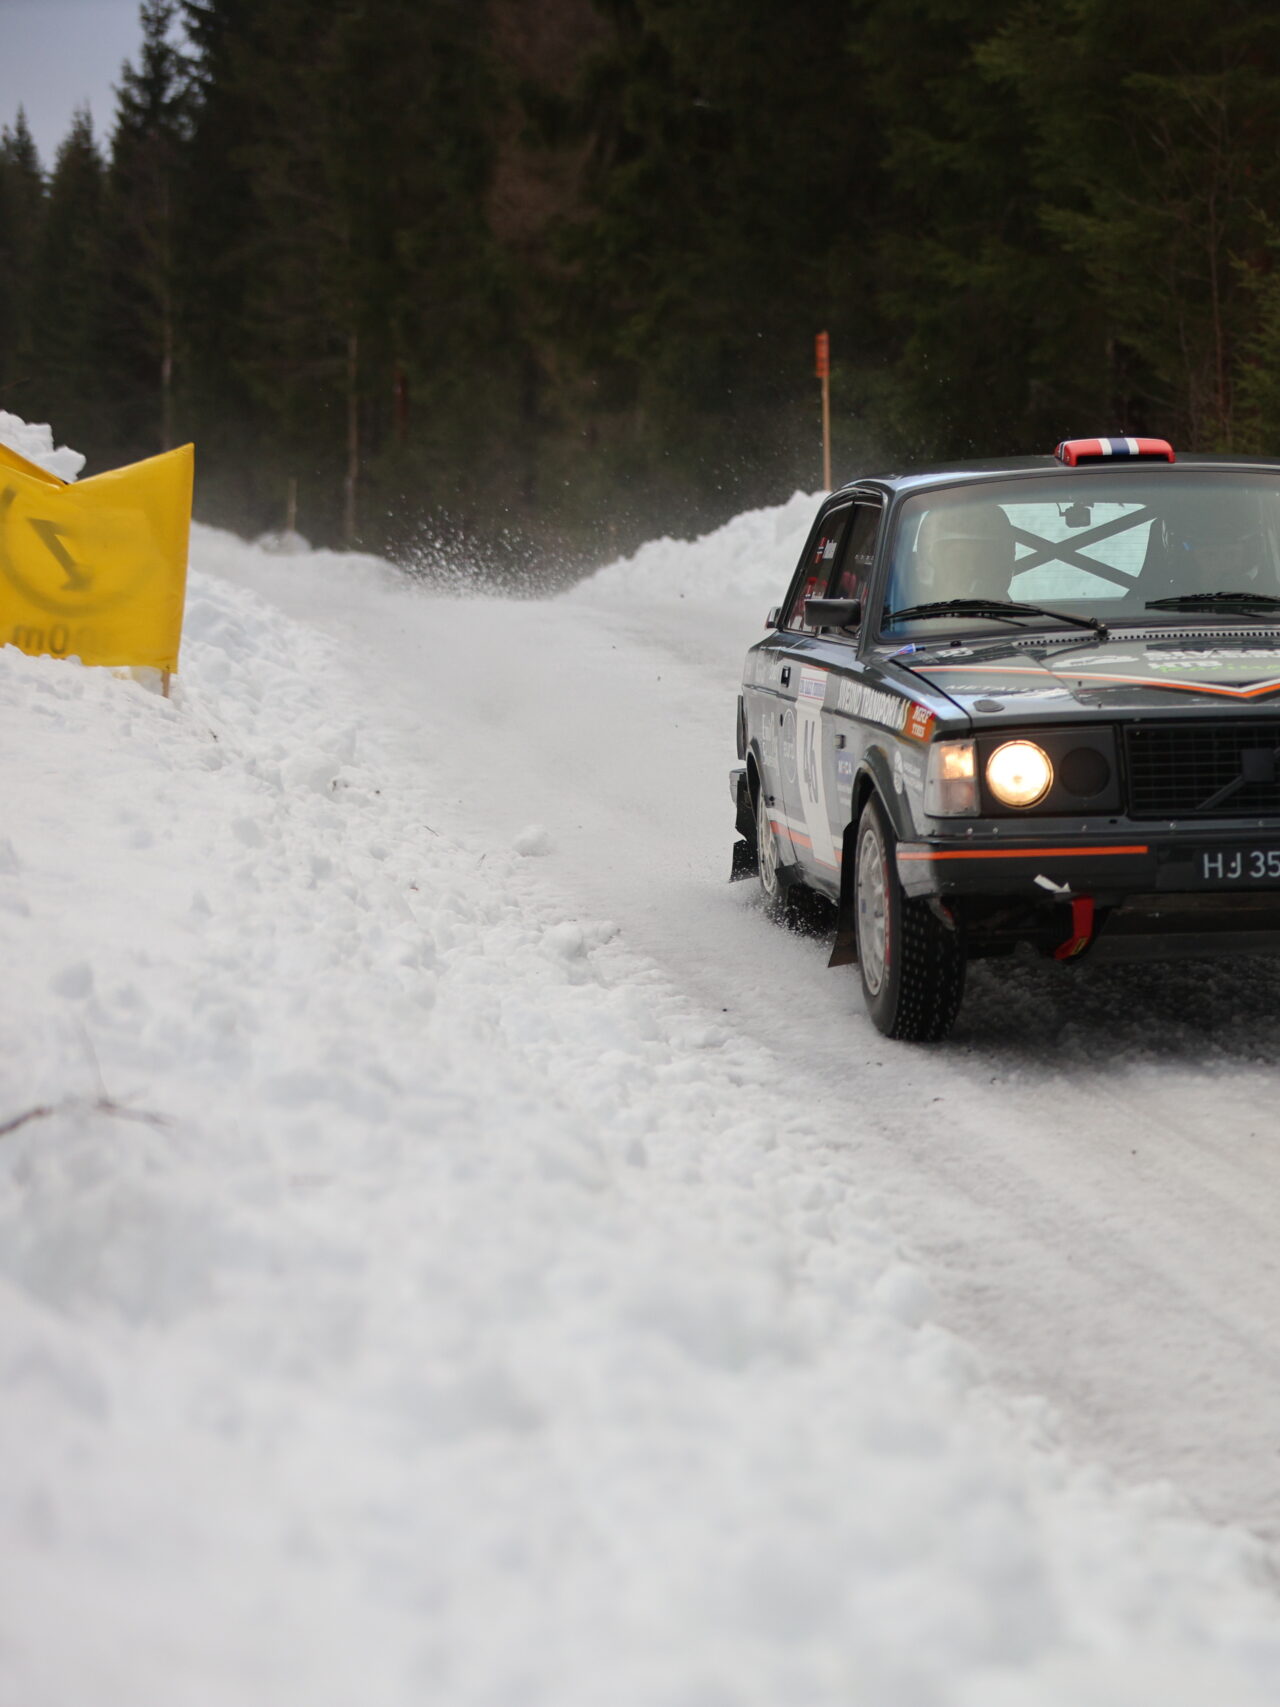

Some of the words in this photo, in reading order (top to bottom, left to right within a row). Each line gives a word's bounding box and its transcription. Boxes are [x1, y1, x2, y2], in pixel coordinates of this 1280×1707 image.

[896, 698, 912, 731] AS
[912, 705, 933, 724] MRF
[803, 719, 819, 803] 46
[1203, 852, 1242, 879] HJ
